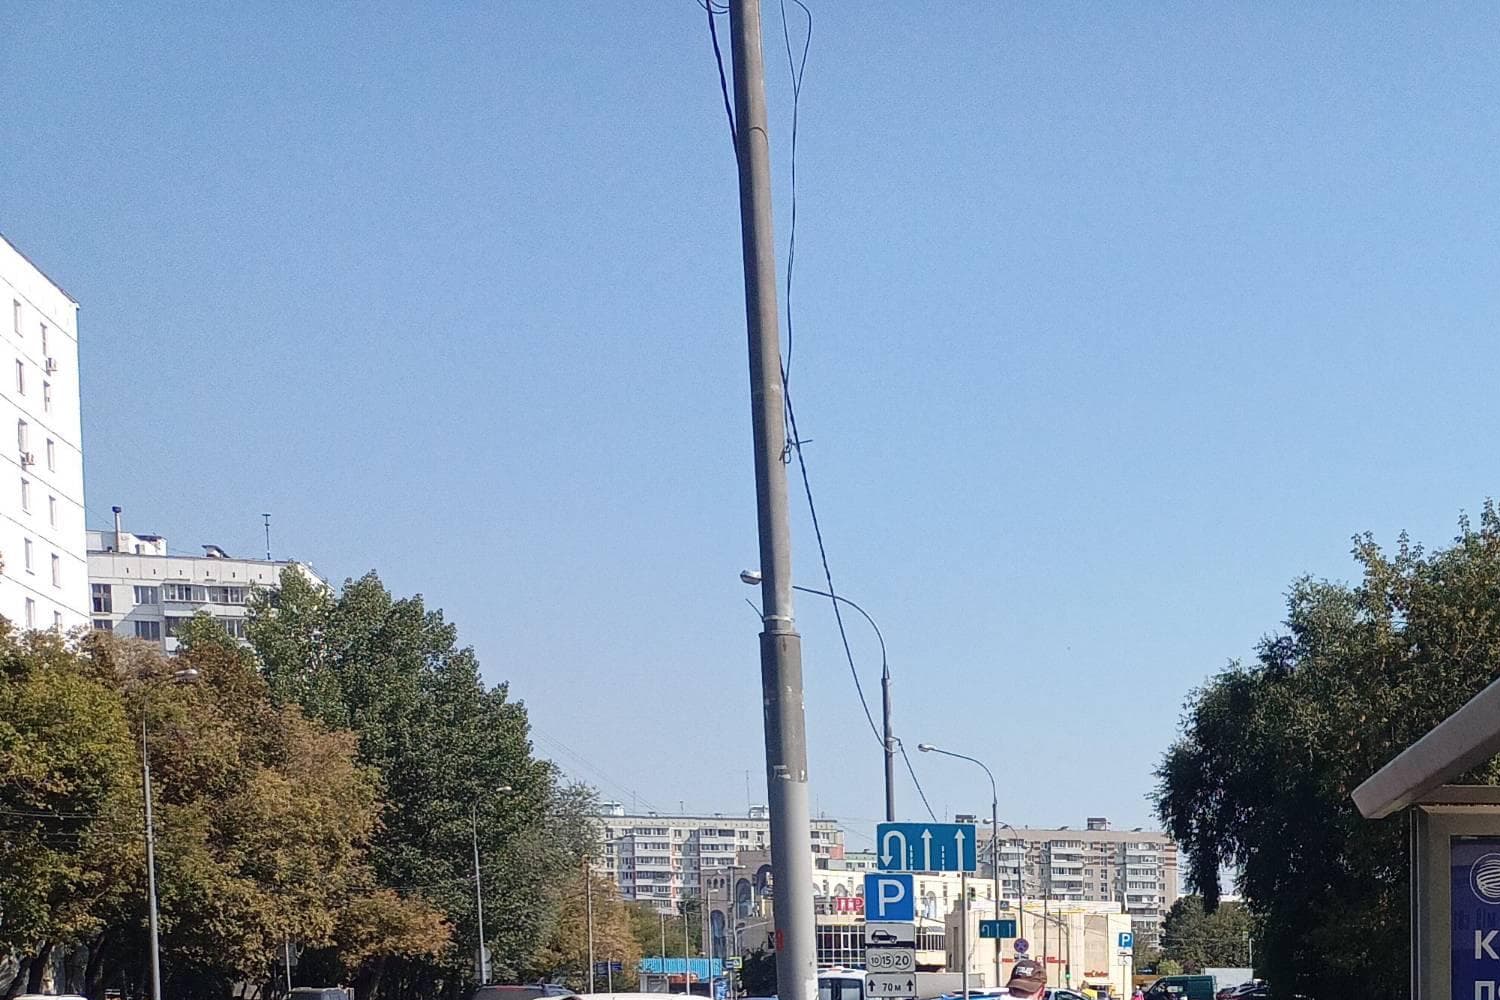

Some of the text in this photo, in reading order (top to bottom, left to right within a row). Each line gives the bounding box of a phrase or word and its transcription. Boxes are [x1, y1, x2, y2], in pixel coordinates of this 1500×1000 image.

[878, 879, 905, 917] P
[881, 956, 891, 965] 15
[895, 955, 909, 966] 20
[882, 983, 894, 992] 70
